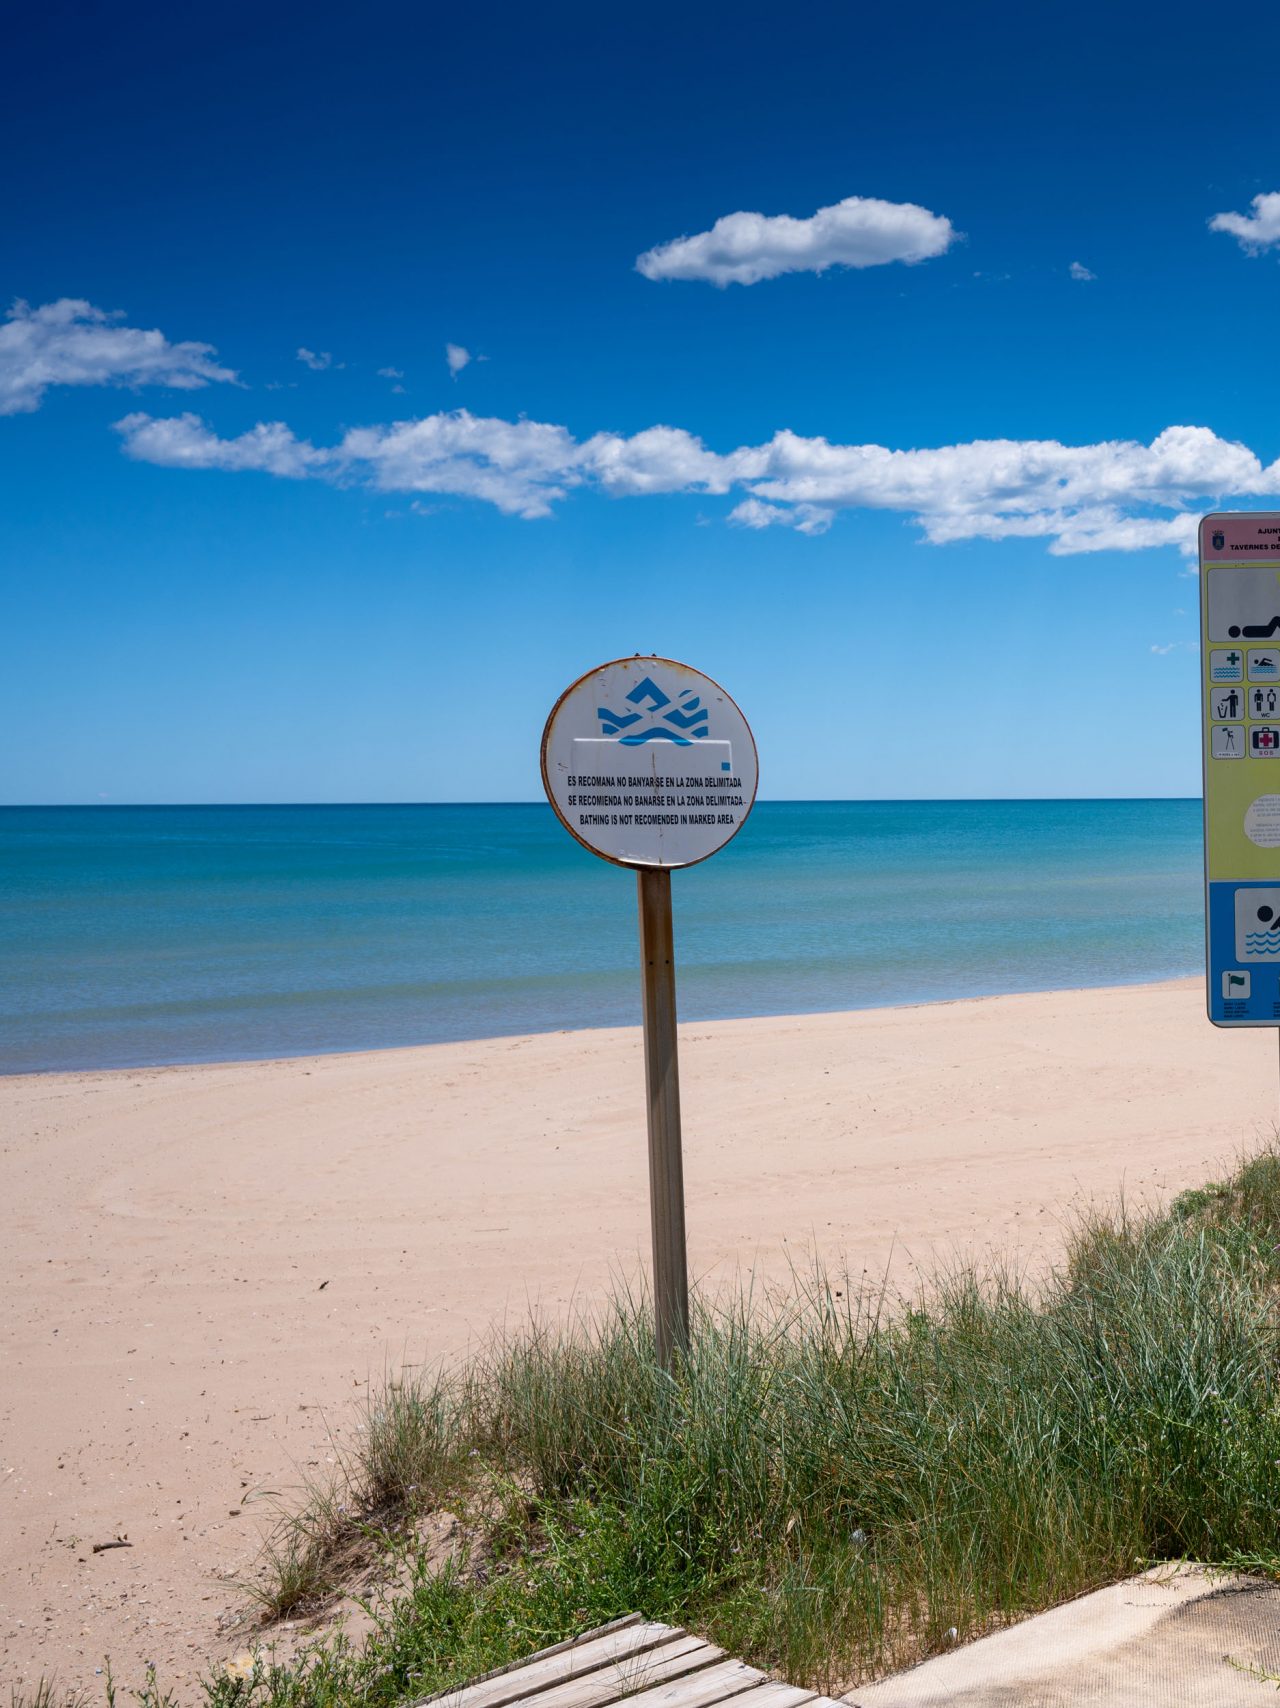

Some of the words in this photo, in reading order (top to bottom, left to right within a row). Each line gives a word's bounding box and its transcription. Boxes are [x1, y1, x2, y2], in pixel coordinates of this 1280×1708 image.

[568, 775, 576, 786] ES
[578, 776, 615, 787] RECOMANA
[617, 776, 627, 787] NO
[628, 777, 664, 787] BANYAR-SE
[665, 777, 675, 787] EN
[676, 777, 684, 787] LA
[686, 777, 703, 787] ZONA
[704, 777, 742, 787] DELIMITADA
[568, 795, 577, 806] SE
[579, 795, 622, 806] RECOMIENDA
[623, 796, 633, 806] NO
[666, 796, 675, 806] EN
[677, 796, 685, 806] LA
[687, 796, 704, 806] ZONA
[705, 796, 743, 806] DELIMITADA
[580, 814, 609, 825] BATHING
[611, 815, 618, 825] IS
[619, 815, 633, 825] NOT
[634, 815, 679, 825] RECOMENDED
[680, 815, 688, 825] IN
[688, 814, 716, 825] MARKED
[717, 814, 734, 825] AREA
